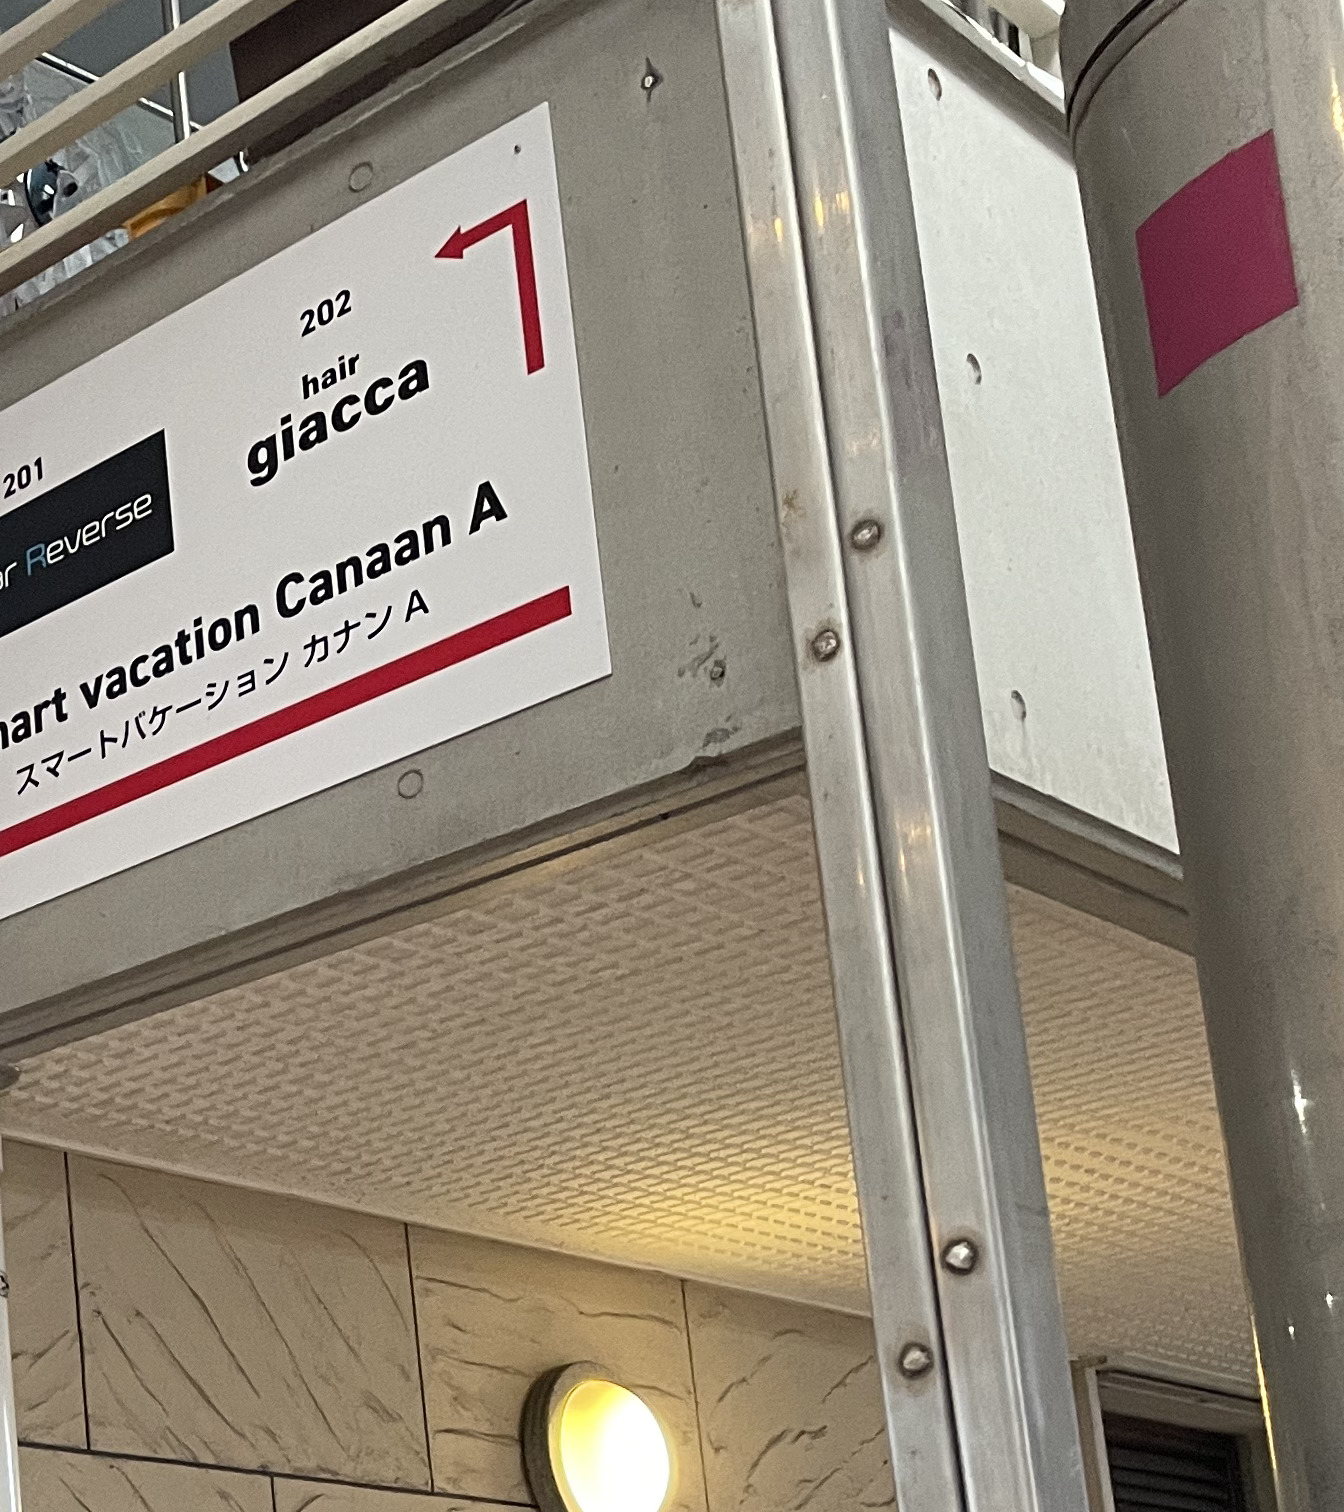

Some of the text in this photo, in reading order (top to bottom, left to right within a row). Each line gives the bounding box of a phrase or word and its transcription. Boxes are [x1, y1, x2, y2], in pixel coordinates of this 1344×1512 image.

[301, 288, 354, 337] 202
[301, 351, 360, 400] hair
[246, 357, 431, 487] giacca
[2, 457, 45, 499] 201
[25, 493, 153, 576] Reverse
[81, 600, 261, 711] vacation
[276, 512, 452, 621] Canaan
[467, 479, 508, 533] A
[15, 592, 430, 796] スマートバケーション カナン A
